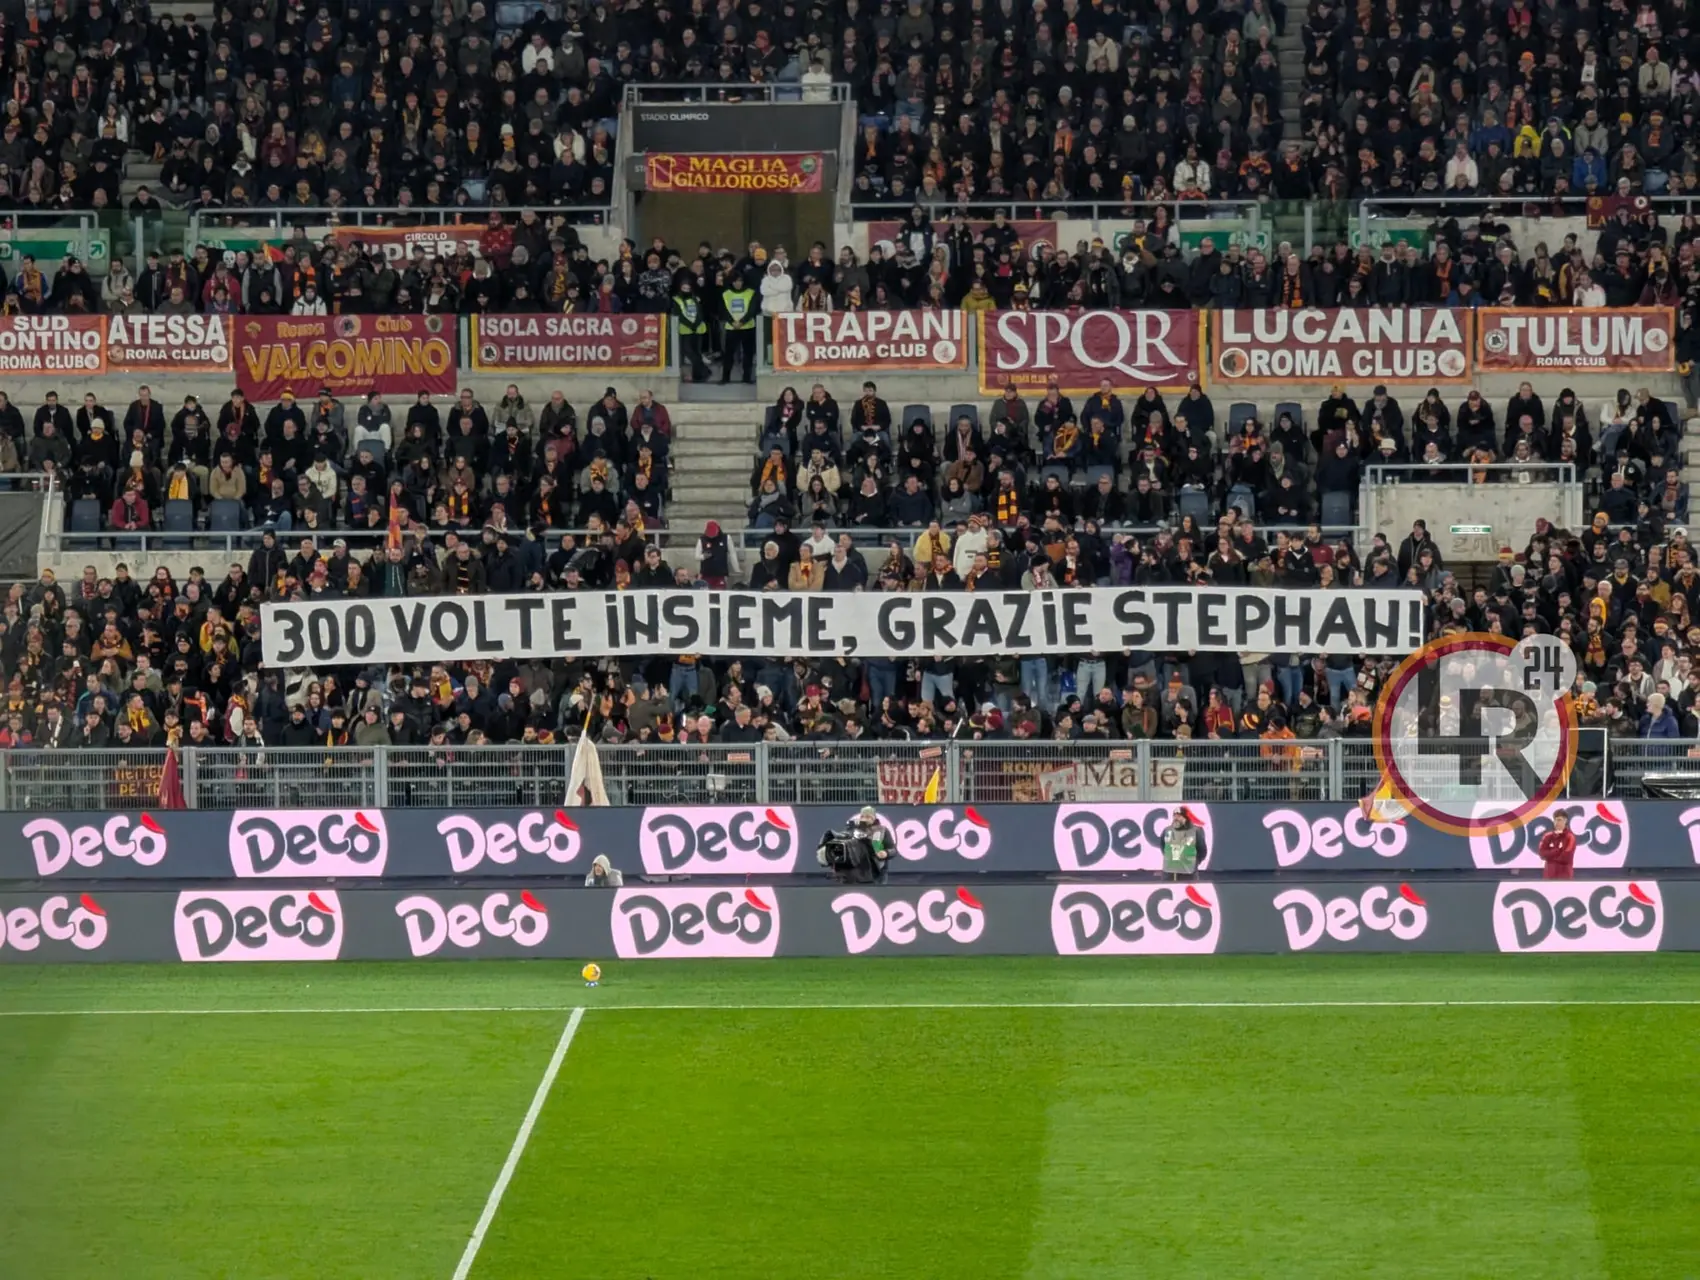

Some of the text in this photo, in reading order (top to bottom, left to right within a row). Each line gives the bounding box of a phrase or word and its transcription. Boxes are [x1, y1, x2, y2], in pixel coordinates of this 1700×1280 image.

[641, 113, 709, 121] STADIO OLIMPICO
[689, 157, 787, 173] MAGLIA
[673, 173, 806, 188] GIALLOROSSA
[405, 232, 448, 241] CIRCOLO
[14, 316, 69, 331] SUD
[108, 315, 226, 345] ATESSA
[480, 318, 614, 336] ISOLA SACRA
[779, 310, 961, 342] TRAPANI
[1222, 309, 1462, 343] LUCANIA
[1500, 317, 1643, 356] TULUM
[504, 346, 612, 361] FIUMICINO
[814, 343, 927, 359] ROMA CLUB
[996, 310, 1188, 382] SPQR
[1, 354, 84, 369] ROMA CLUB
[126, 349, 210, 360] ROMA CLUB
[242, 338, 451, 383] VALCOMINO
[1536, 357, 1607, 366] ROMA CLUB
[1250, 350, 1436, 376] ROMA CLUB
[273, 604, 376, 662] 300
[390, 597, 582, 653] VOLTE
[1113, 592, 1420, 648] STEPHAN!
